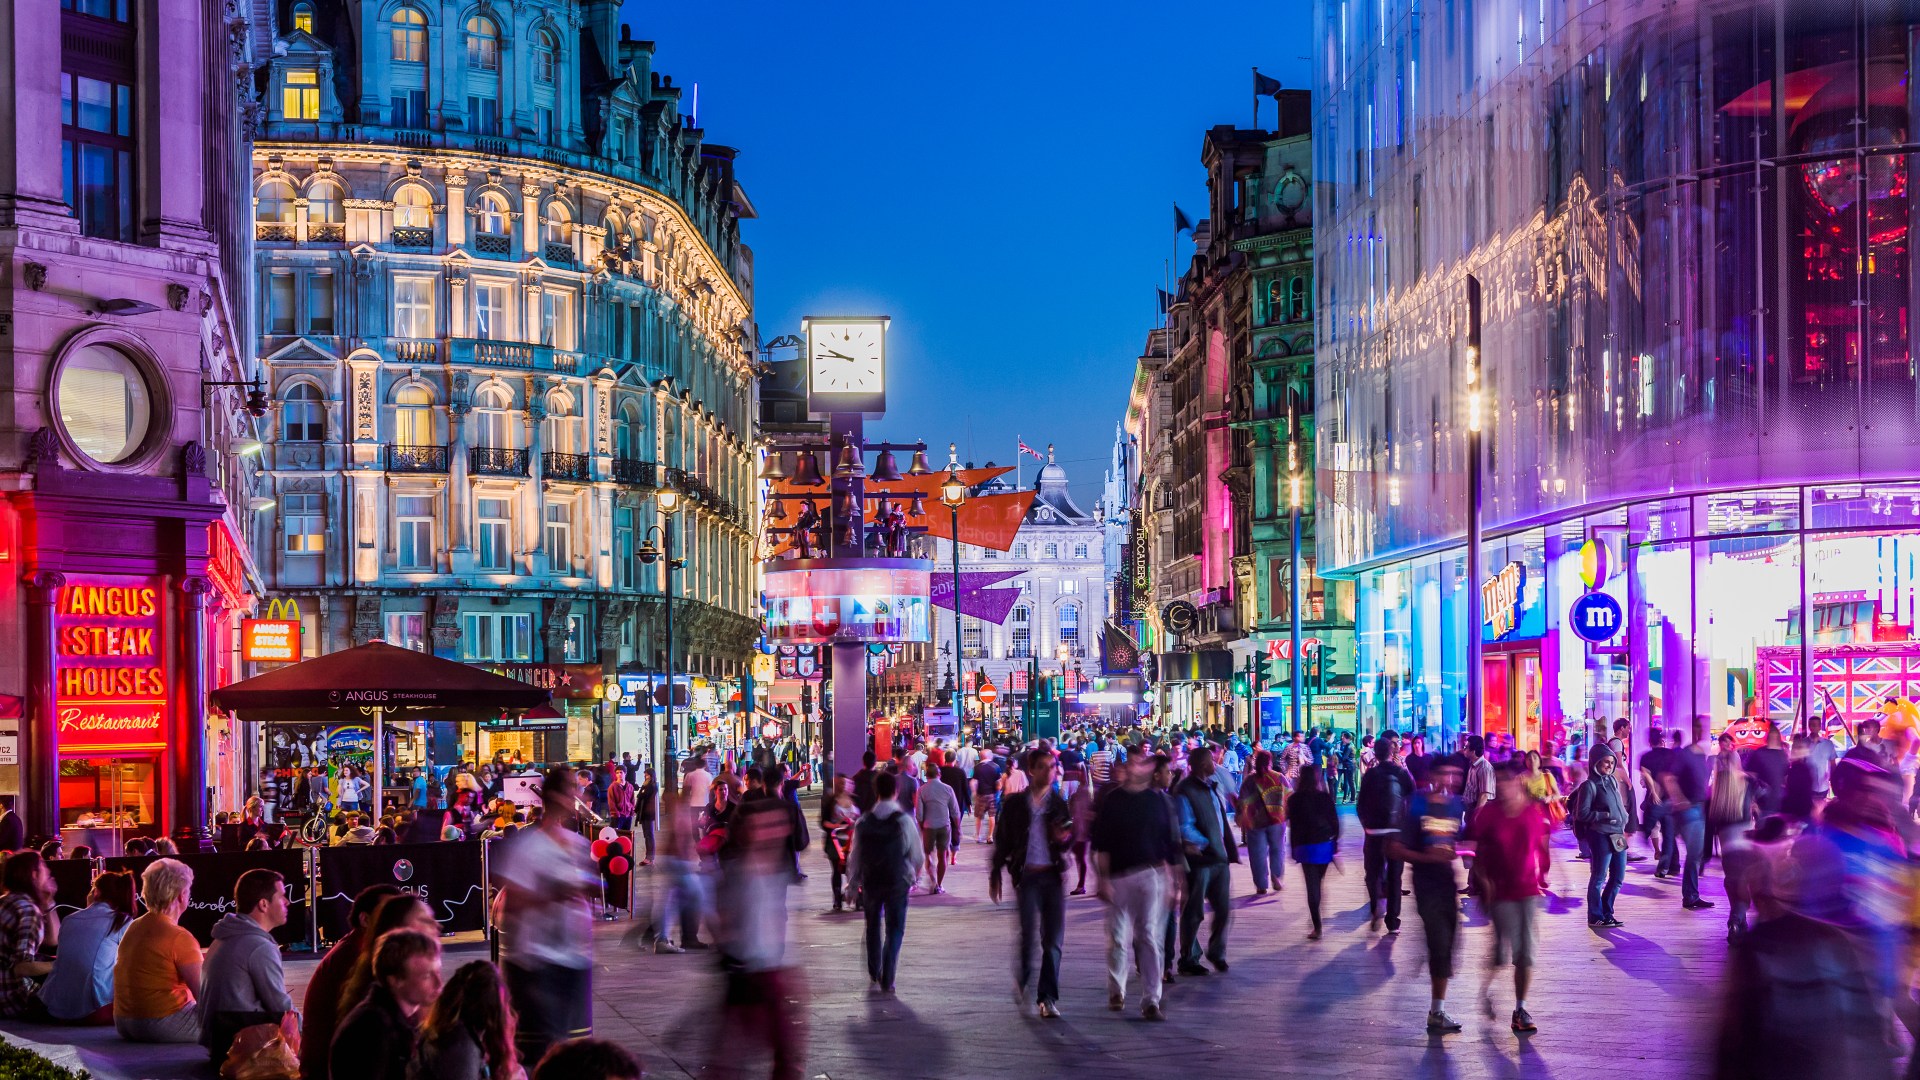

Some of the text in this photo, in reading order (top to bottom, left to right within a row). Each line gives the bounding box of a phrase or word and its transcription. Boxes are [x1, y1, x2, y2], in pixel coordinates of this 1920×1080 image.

[1136, 527, 1147, 586] TROCADERO
[71, 586, 156, 616] ANGUS
[1585, 606, 1613, 627] m
[252, 623, 290, 634] ANGUS
[72, 626, 154, 656] STEAK
[254, 635, 288, 646] STEAK
[1266, 637, 1320, 660] KC
[250, 647, 291, 658] HOUSES
[66, 667, 164, 696] HOUSES
[626, 681, 658, 693] MONY
[345, 690, 389, 701] ANGUS
[60, 708, 161, 732] Restaurant
[330, 739, 359, 750] WIZARD
